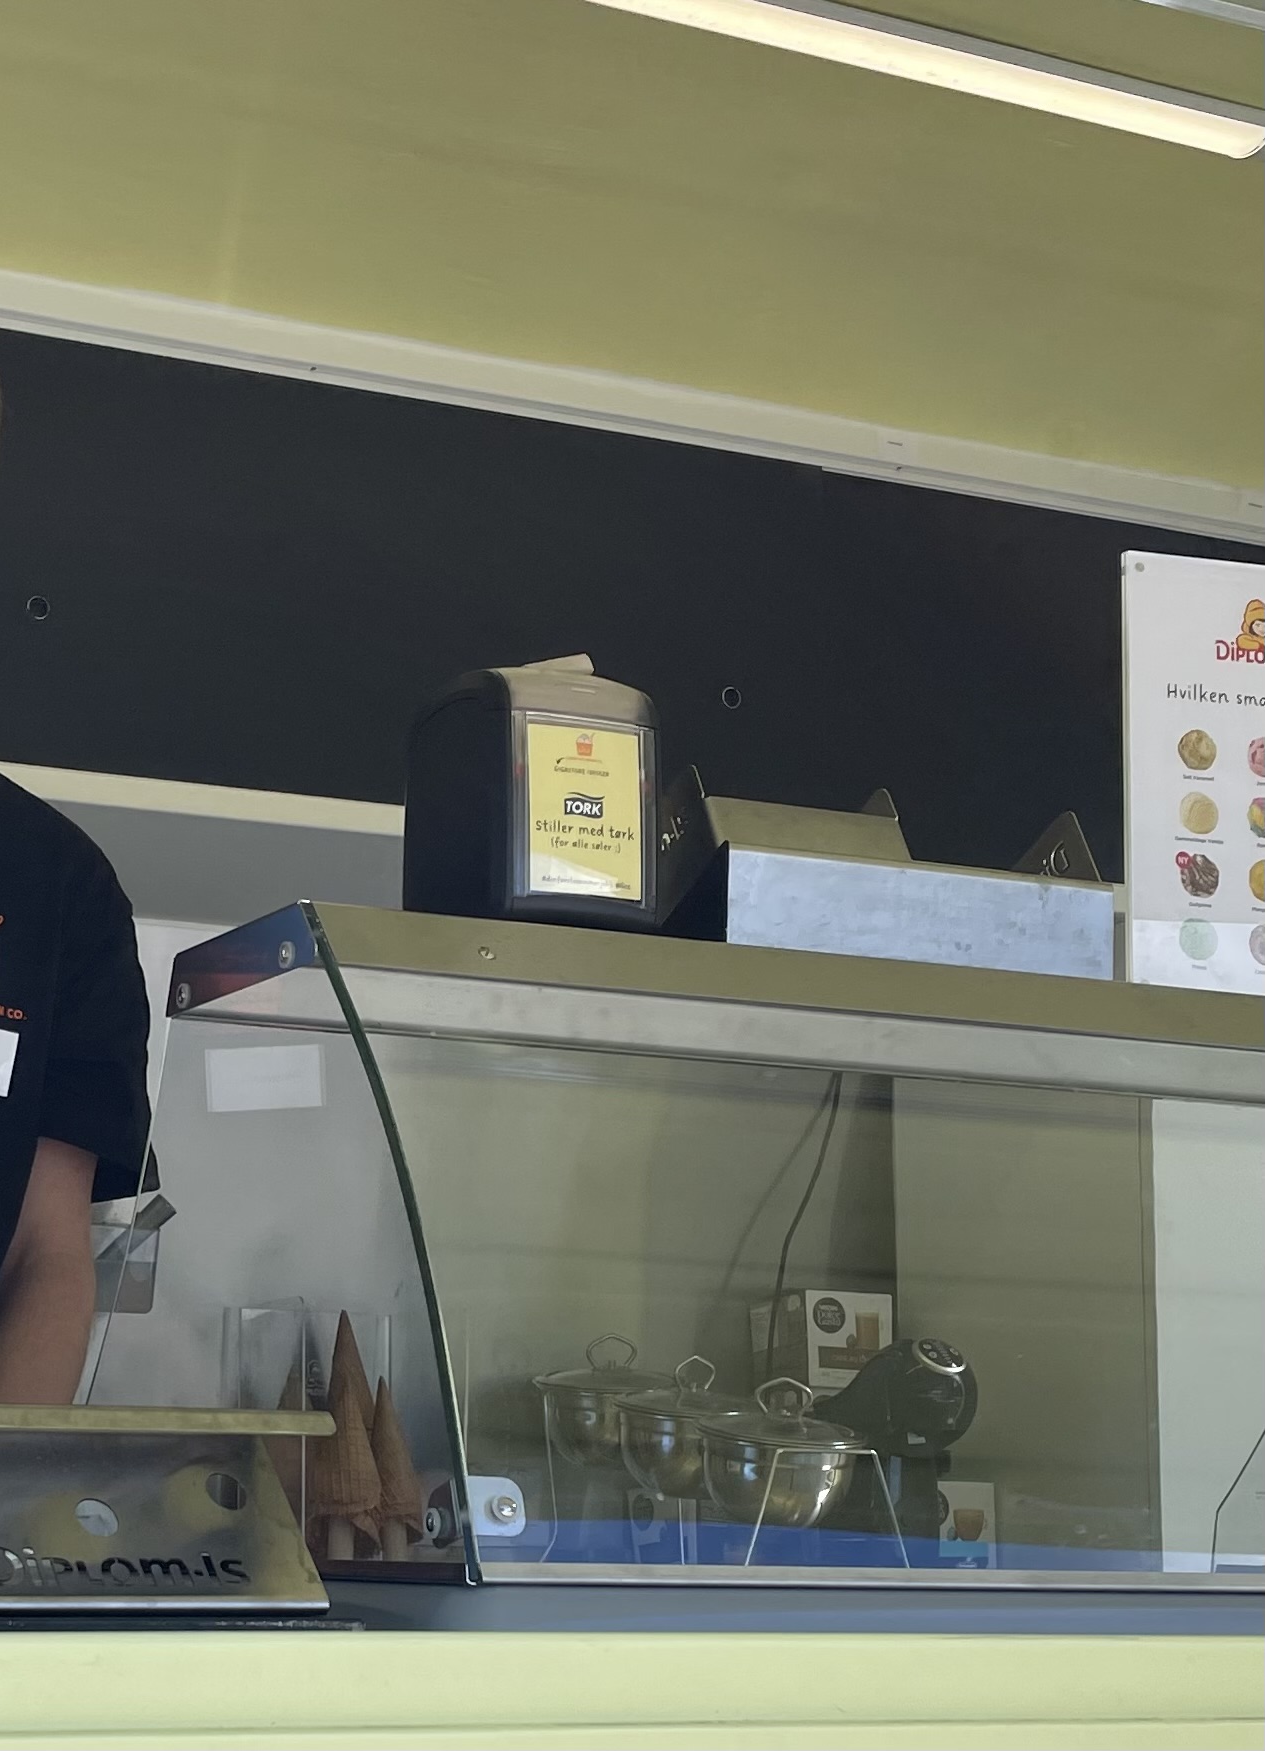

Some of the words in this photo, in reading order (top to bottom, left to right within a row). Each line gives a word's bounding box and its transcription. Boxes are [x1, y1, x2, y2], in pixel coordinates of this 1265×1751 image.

[1167, 683, 1230, 704] Hvilken
[566, 801, 602, 816] TORK
[536, 819, 574, 834] Stiller
[578, 824, 604, 838] med
[572, 839, 588, 849] alle
[1178, 855, 1189, 865] NY
[6, 1008, 27, 1020] CO.
